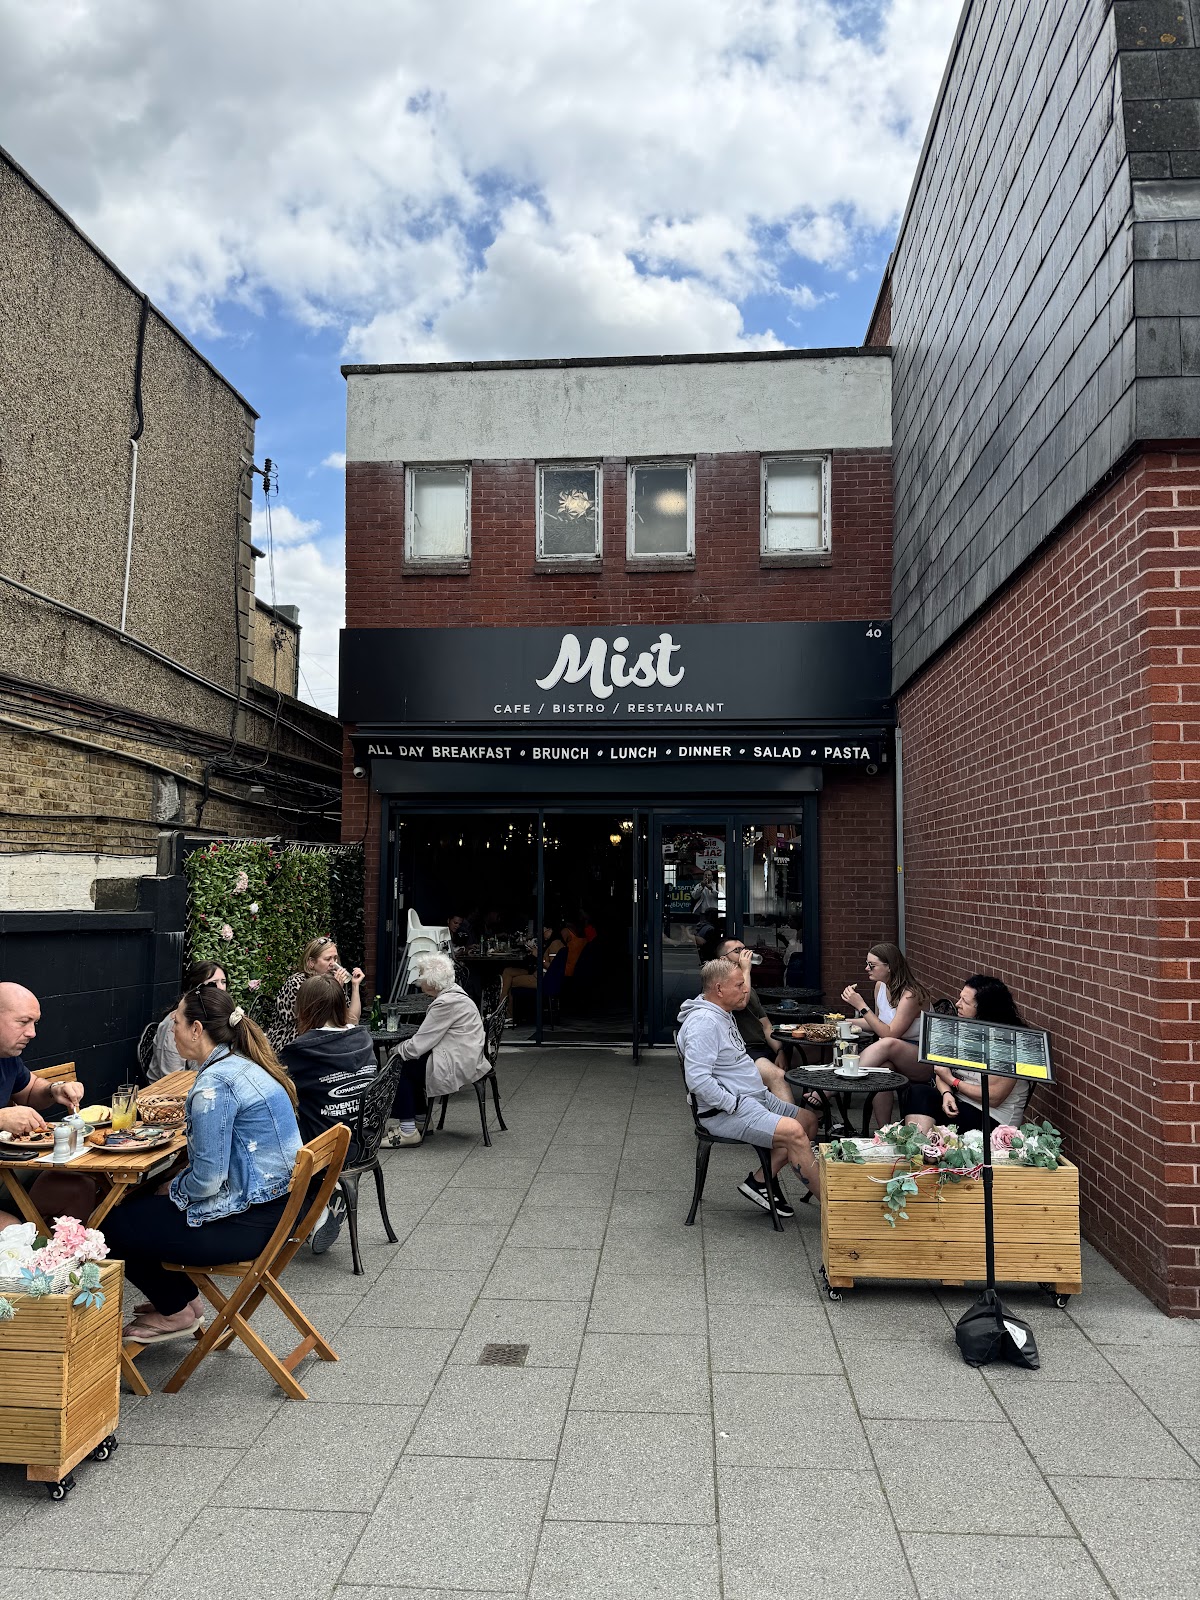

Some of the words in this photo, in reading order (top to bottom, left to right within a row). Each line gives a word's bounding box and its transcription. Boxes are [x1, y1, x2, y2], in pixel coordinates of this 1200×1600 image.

[866, 629, 881, 638] 40
[536, 632, 685, 699] Mist
[494, 704, 531, 714] CAFE
[553, 703, 605, 714] BISTRO
[628, 702, 724, 713] RESTAURANT
[367, 745, 393, 756] ALL
[399, 747, 424, 758] DAY
[433, 747, 512, 759] BREAKFAST
[533, 747, 588, 760] BRUNCH
[610, 747, 657, 760] LUNCH
[679, 746, 731, 758] DINNER
[754, 746, 802, 758] SALAD
[825, 746, 871, 760] PASTA
